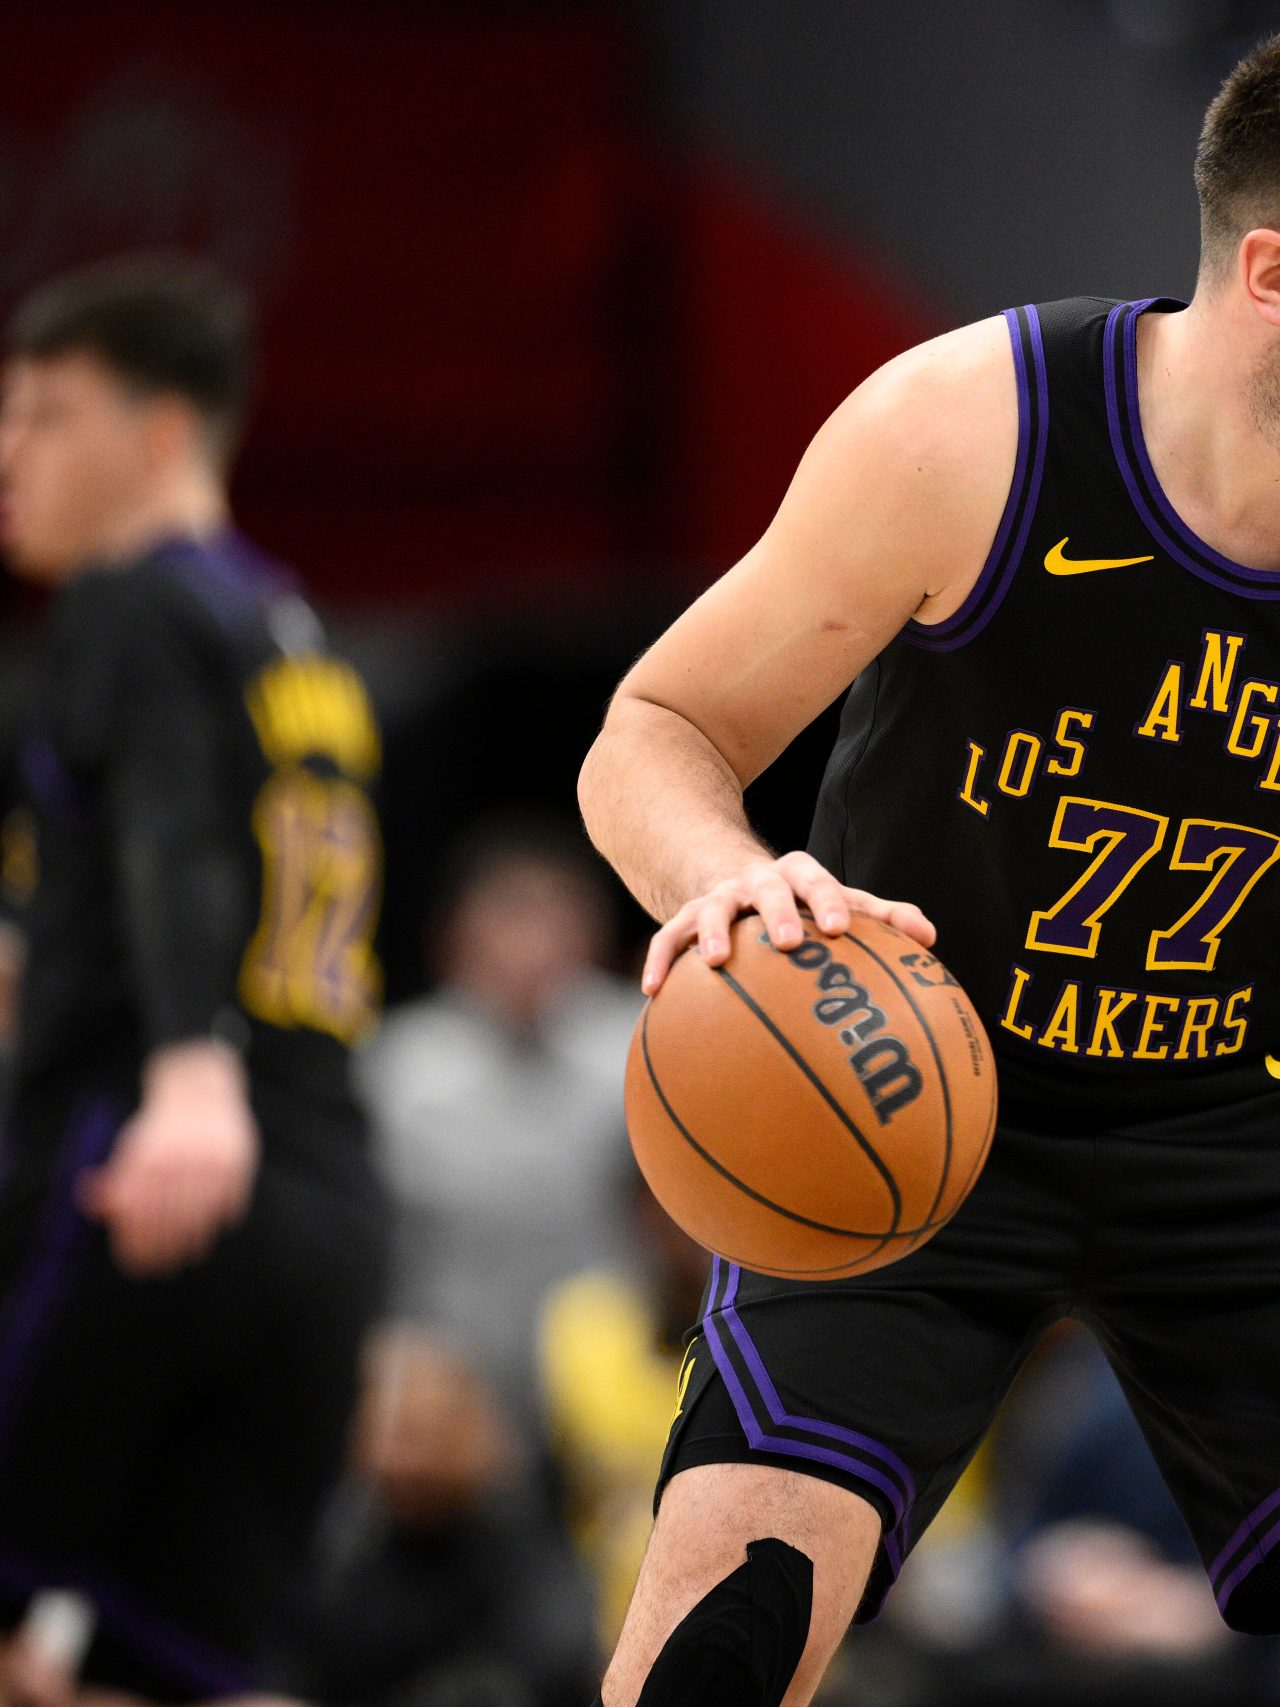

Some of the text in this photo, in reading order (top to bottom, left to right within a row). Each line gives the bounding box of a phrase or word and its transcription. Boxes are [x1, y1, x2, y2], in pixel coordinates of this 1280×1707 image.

[959, 708, 1096, 817] LOS
[757, 927, 924, 1127] Wilso
[998, 964, 1254, 1060] LAKERS
